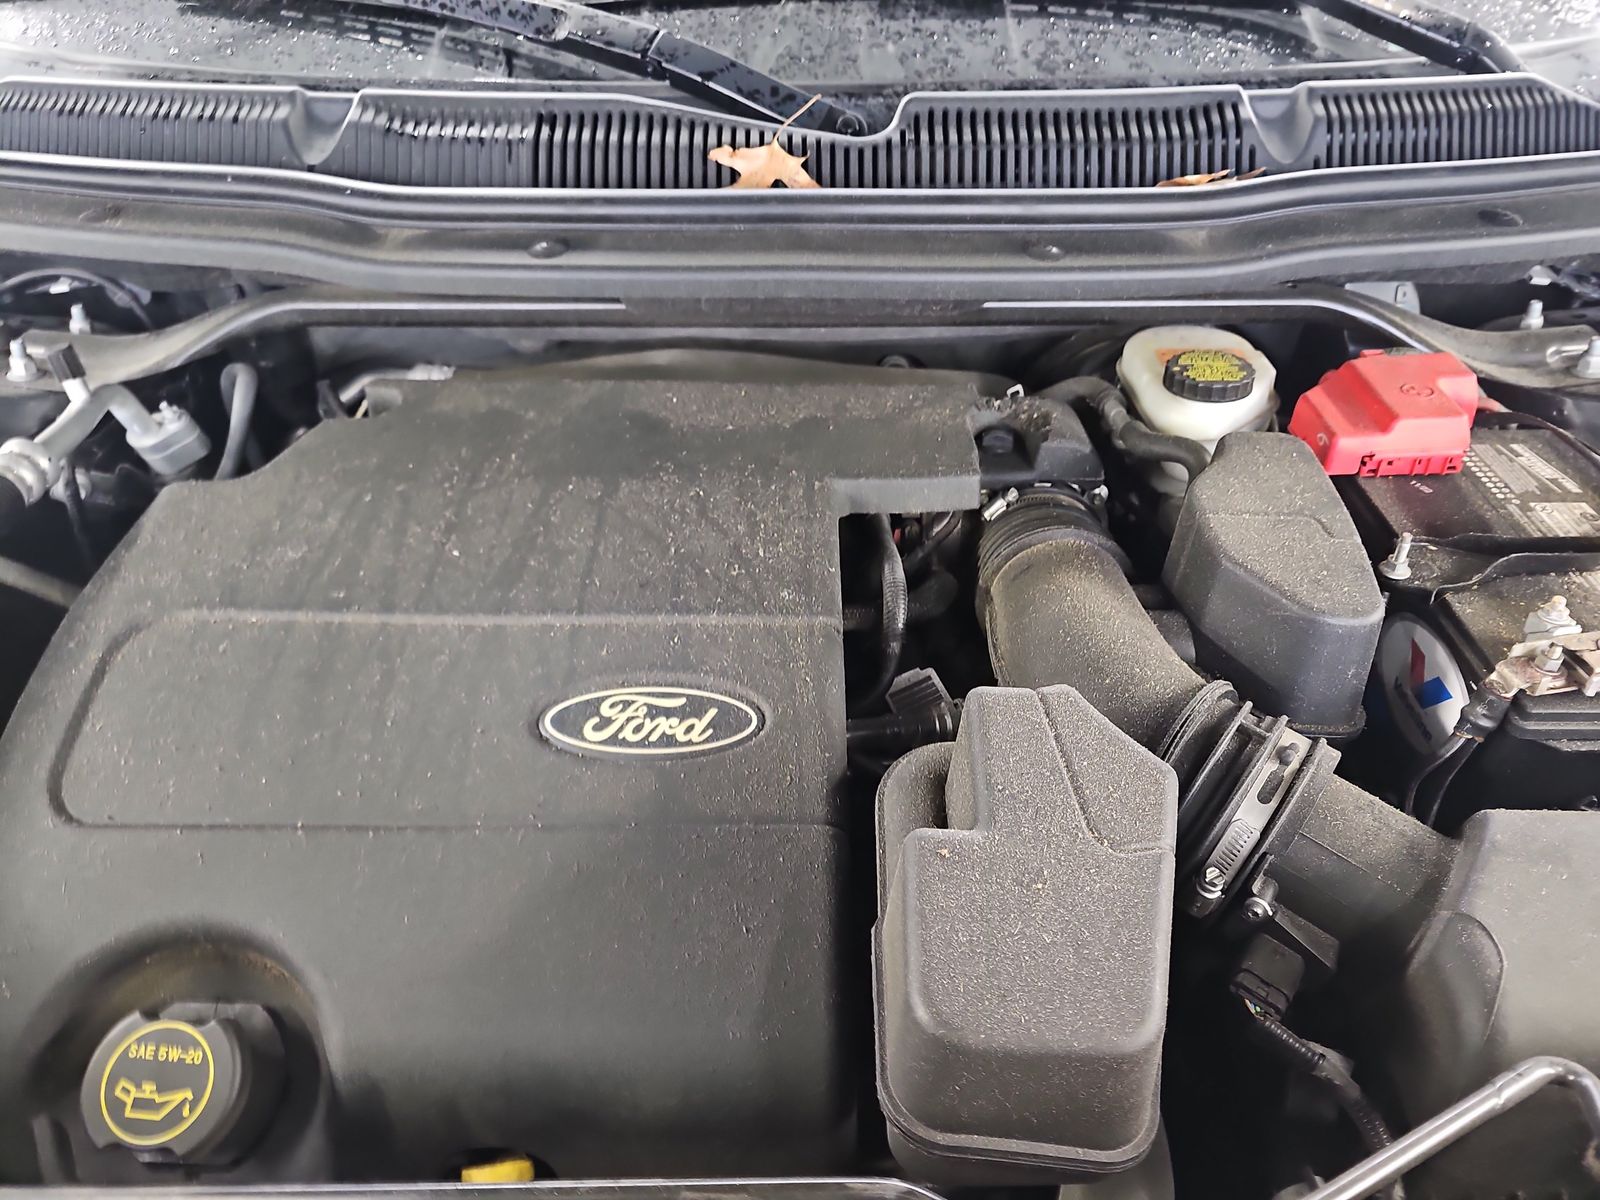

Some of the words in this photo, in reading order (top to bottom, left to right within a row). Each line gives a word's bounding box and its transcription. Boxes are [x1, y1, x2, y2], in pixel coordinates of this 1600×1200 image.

[583, 694, 718, 743] Ford
[128, 1040, 156, 1061] SAE
[158, 1042, 203, 1065] 5W-20
